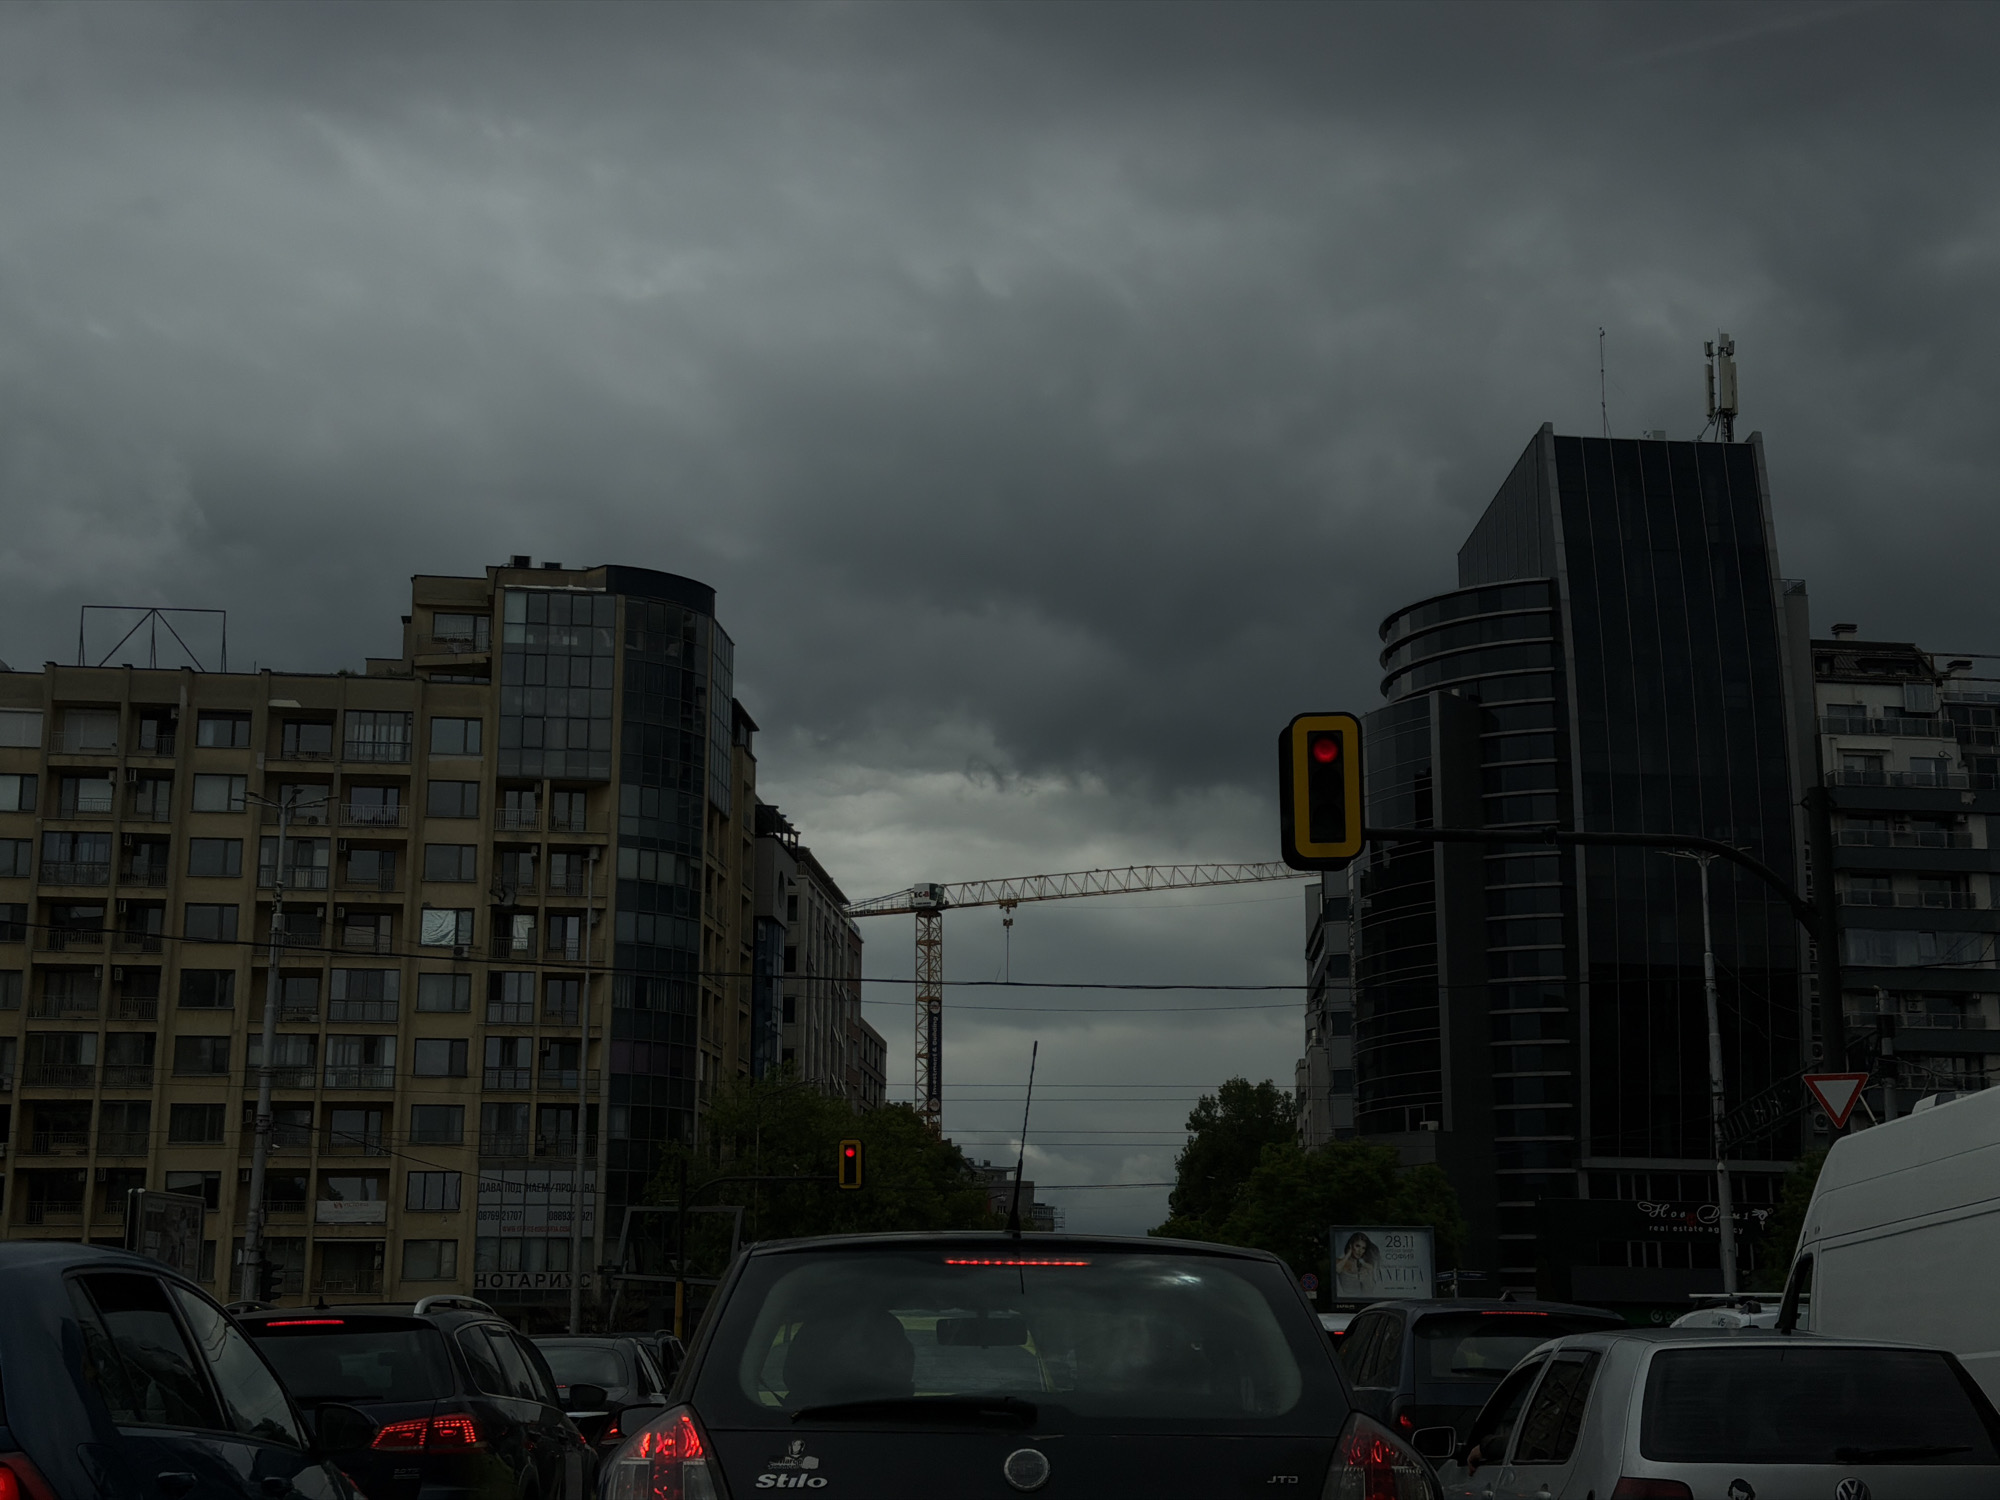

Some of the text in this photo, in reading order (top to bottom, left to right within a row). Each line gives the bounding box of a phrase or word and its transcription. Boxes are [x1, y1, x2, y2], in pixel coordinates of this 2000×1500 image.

[504, 1182, 522, 1193] ПОД
[1649, 1224, 1669, 1232] real
[1707, 1227, 1744, 1235] agcy
[1385, 1235, 1414, 1248] 28.11
[755, 1473, 828, 1489] Stilo
[1266, 1475, 1299, 1484] JTD
